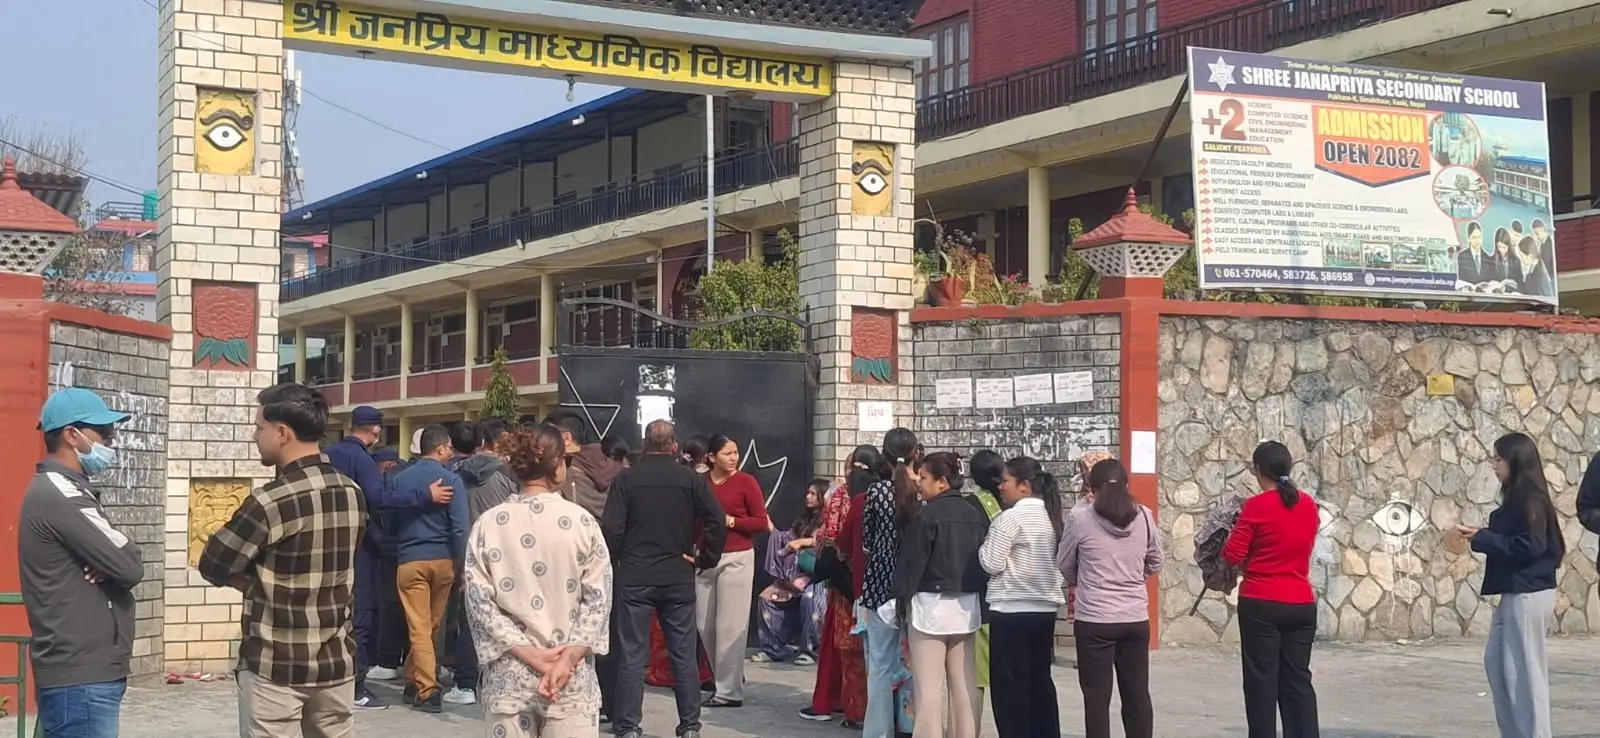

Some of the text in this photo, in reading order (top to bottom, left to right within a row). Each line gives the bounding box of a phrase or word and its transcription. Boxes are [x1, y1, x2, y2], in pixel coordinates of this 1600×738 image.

[294, 0, 823, 89] श्री जनप्रिय माध्यमिक विद्यालय
[1242, 66, 1521, 109] SHREE JANAPRIYA SECONDARY SCHOOL
[1202, 99, 1247, 140] +2
[1265, 120, 1307, 128] ENGINEERING
[1318, 107, 1425, 143] ADMISSION
[1249, 128, 1292, 136] MANAGEMENT
[1324, 141, 1421, 169] OPEN 2082
[1210, 158, 1240, 166] DEDICATED
[1211, 168, 1248, 176] EDUCATIONAL
[1228, 178, 1251, 186] ENGLISH
[1332, 203, 1353, 211] SCIENCE
[1241, 208, 1271, 216] COMPUTER
[1239, 218, 1267, 226] CULTURAL
[1311, 221, 1328, 229] OTHER
[1373, 225, 1401, 233] ACTIVITIES
[1232, 246, 1257, 254] TRAINING
[1223, 268, 1354, 282] 061-570464, 583726, 586958
